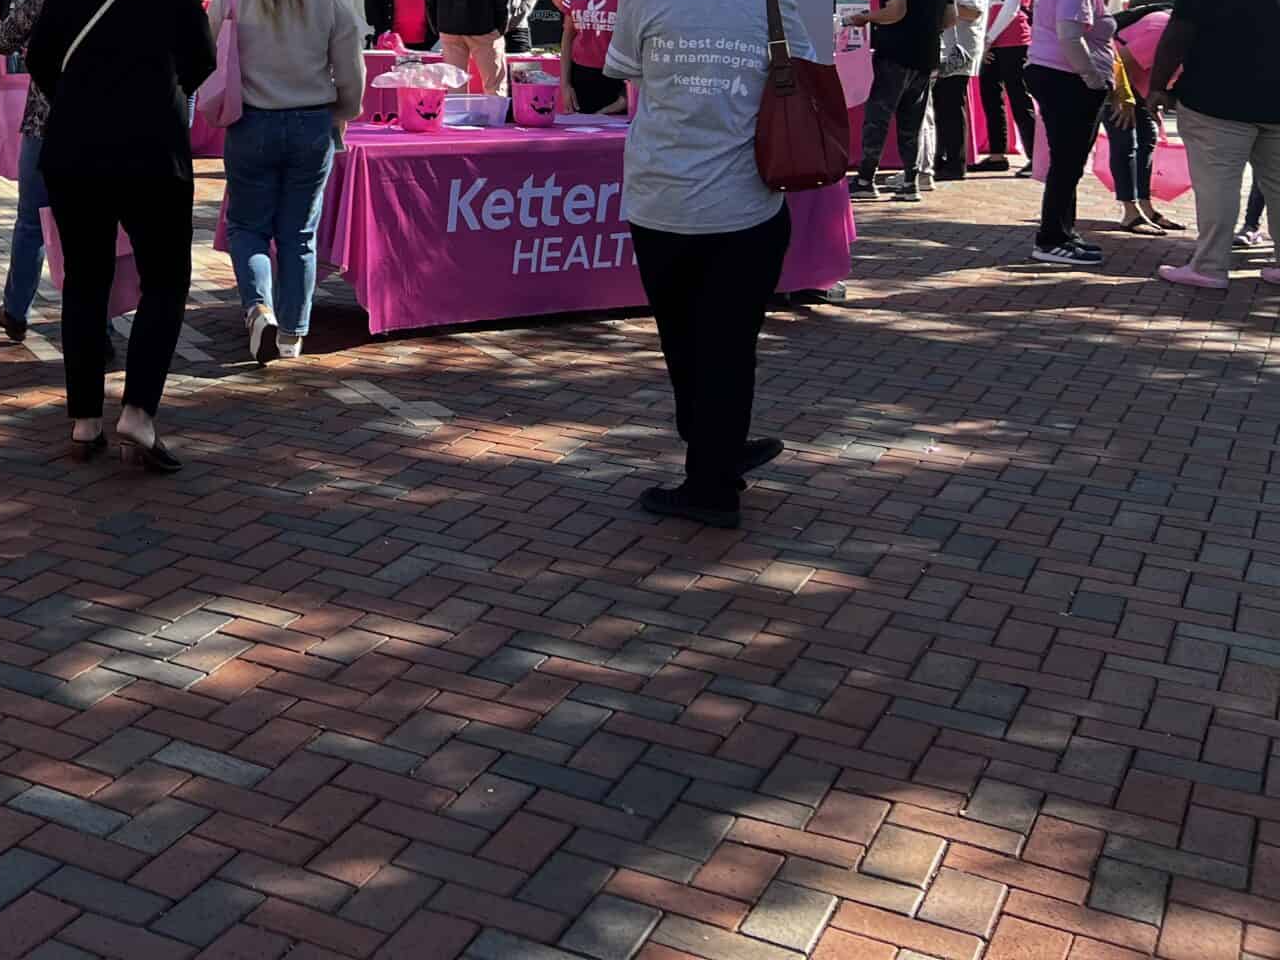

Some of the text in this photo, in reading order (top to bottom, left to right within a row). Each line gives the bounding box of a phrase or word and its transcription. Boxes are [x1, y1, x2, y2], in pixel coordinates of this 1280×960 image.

[651, 37, 677, 49] The
[679, 36, 711, 49] best
[663, 54, 672, 63] a
[447, 172, 629, 233] Ketter
[511, 232, 638, 275] HEALT
